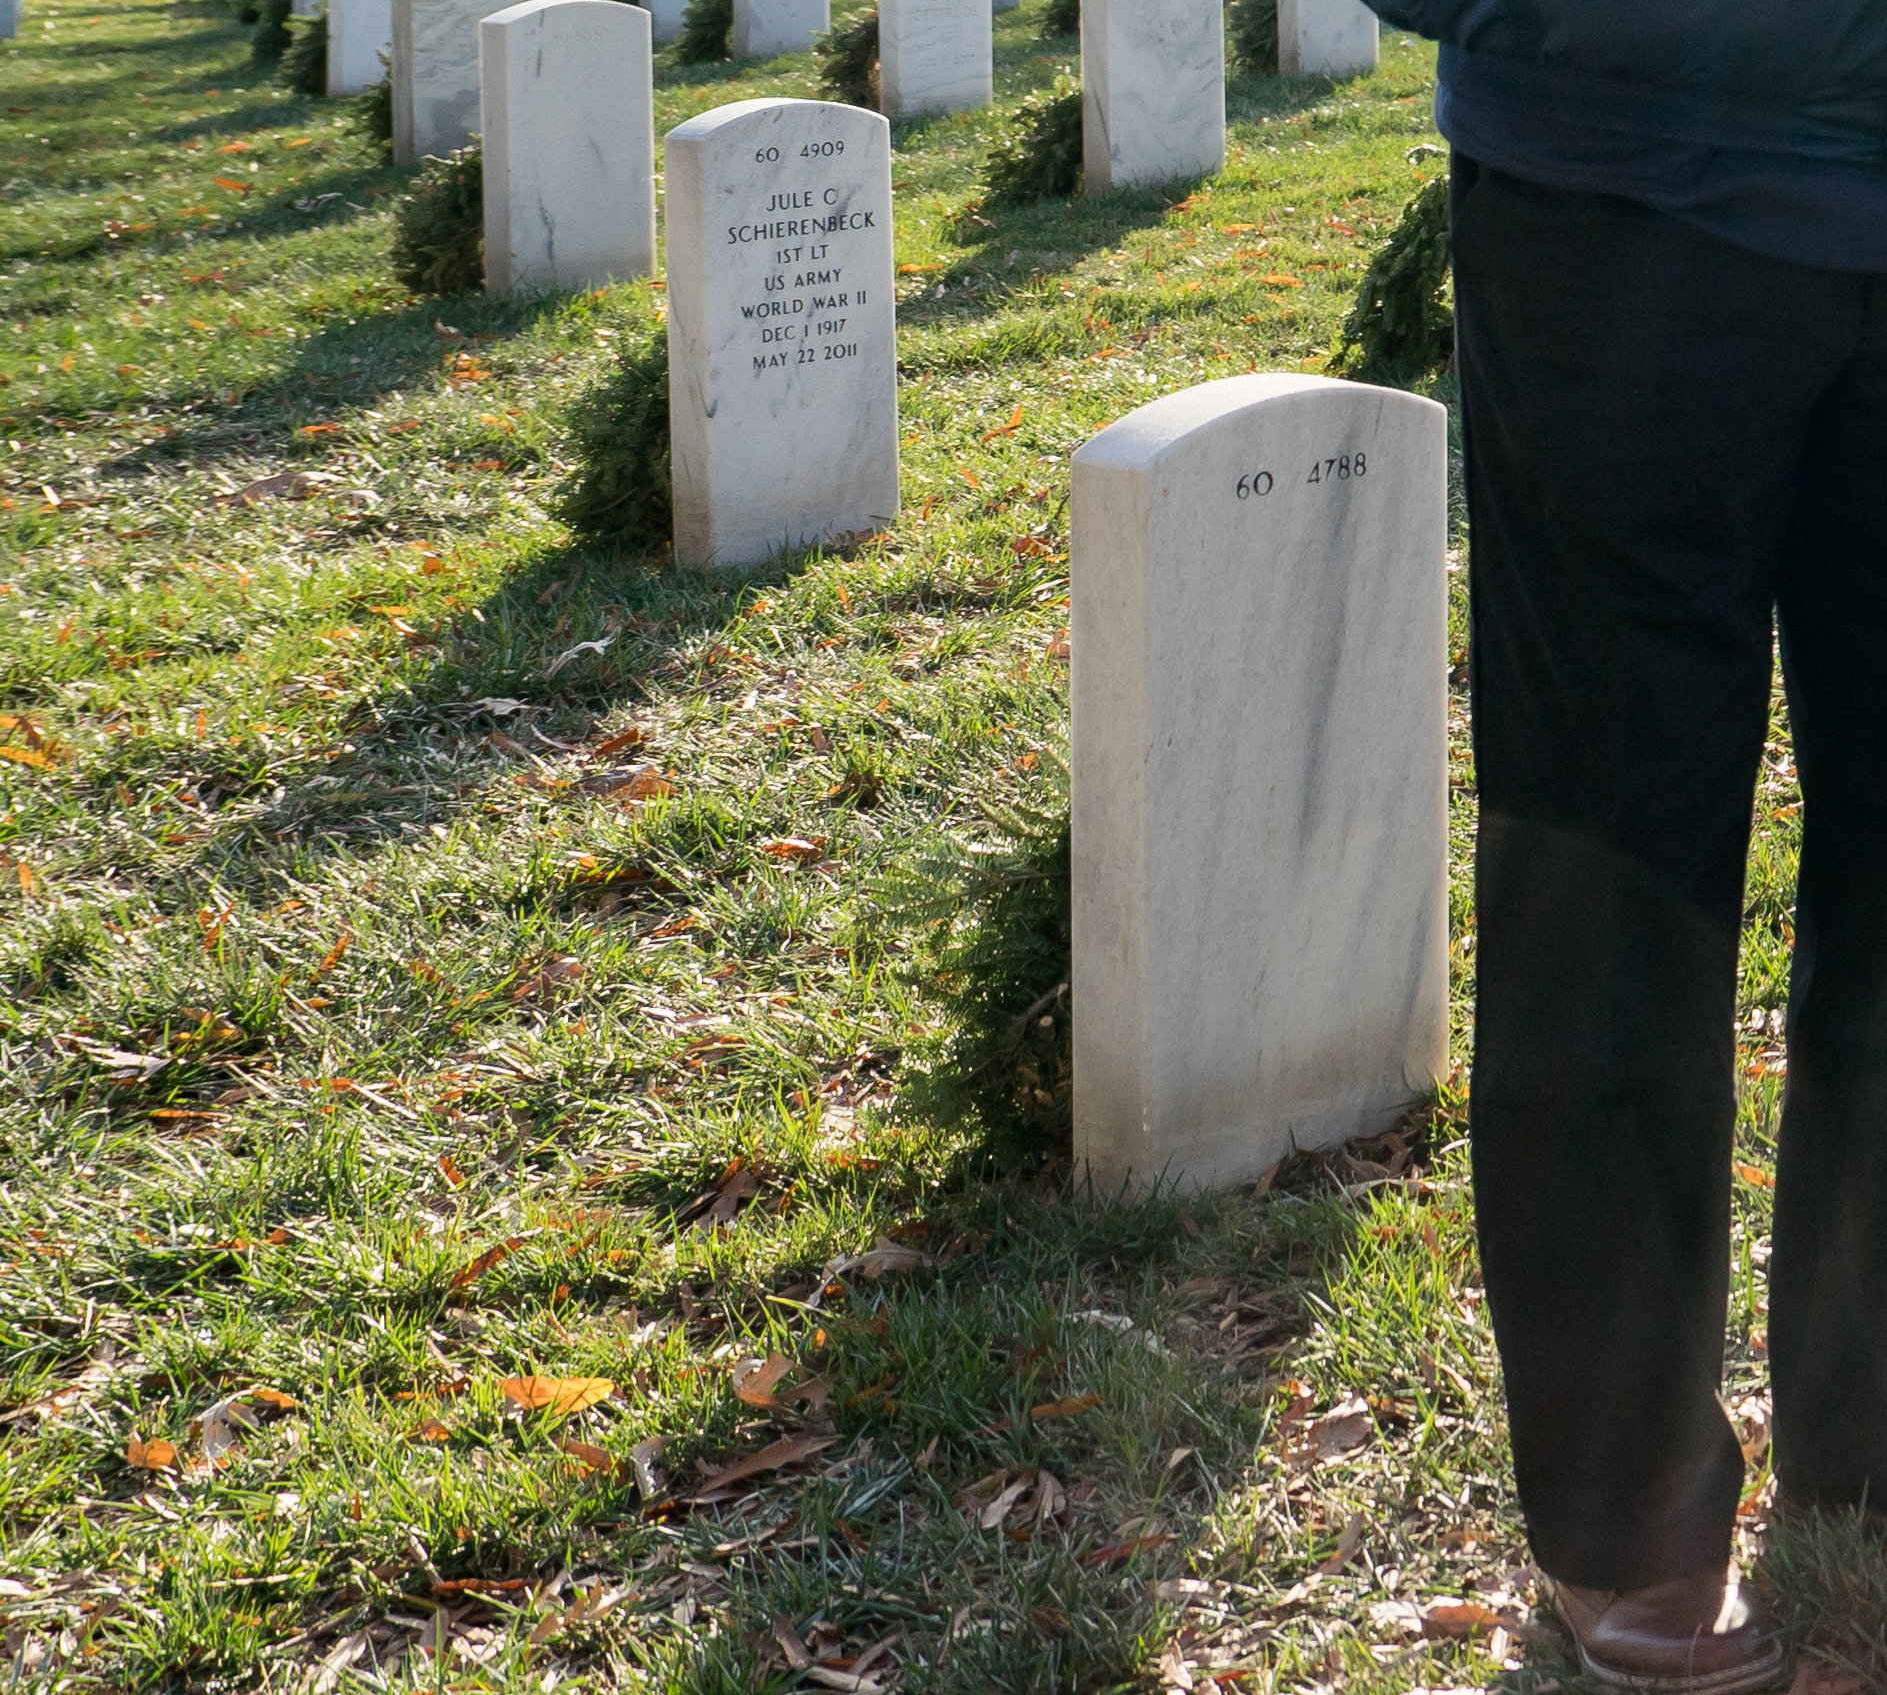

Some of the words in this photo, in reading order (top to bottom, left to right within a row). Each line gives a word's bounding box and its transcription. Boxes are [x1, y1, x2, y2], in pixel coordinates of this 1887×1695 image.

[756, 147, 780, 164] 60
[800, 141, 845, 158] 4909
[766, 190, 813, 211] JULE
[823, 188, 838, 205] C
[728, 211, 876, 244] SCHIERENBECK
[811, 244, 830, 260] LT
[765, 274, 785, 292] US
[794, 269, 843, 288] ARMY
[741, 299, 804, 319] WORLD
[813, 293, 848, 309] WAR
[762, 325, 796, 343] DEC
[817, 318, 848, 336] 1917
[753, 352, 788, 371] MAY
[797, 347, 816, 364] 22
[824, 343, 858, 361] 2011
[1236, 470, 1274, 500] 60
[1307, 452, 1367, 485] 4788
